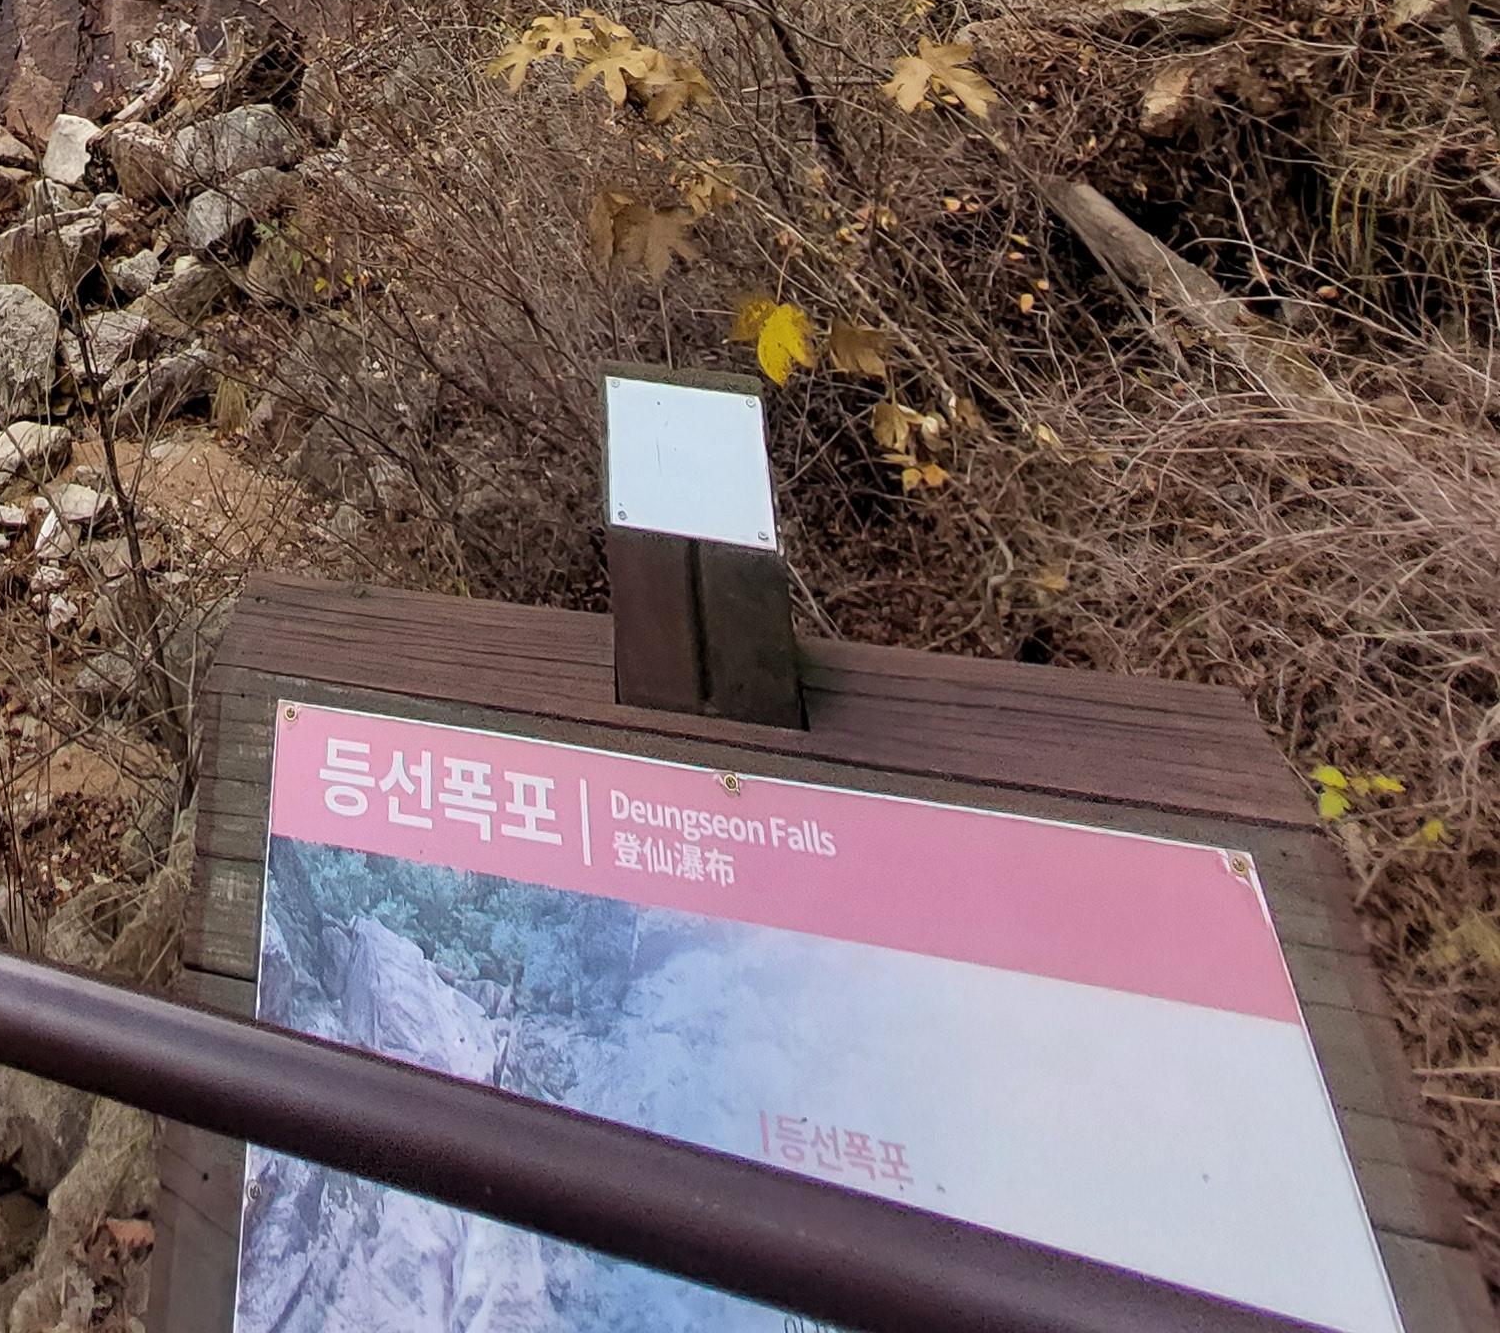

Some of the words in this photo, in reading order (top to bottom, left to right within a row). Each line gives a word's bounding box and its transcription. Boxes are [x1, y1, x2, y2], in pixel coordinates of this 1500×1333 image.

[319, 737, 562, 846] 등선폭포
[610, 789, 766, 842] Deungseon
[769, 817, 837, 858] Falls
[612, 831, 736, 888] 登仙瀑布
[775, 1113, 915, 1184] 등선폭포
